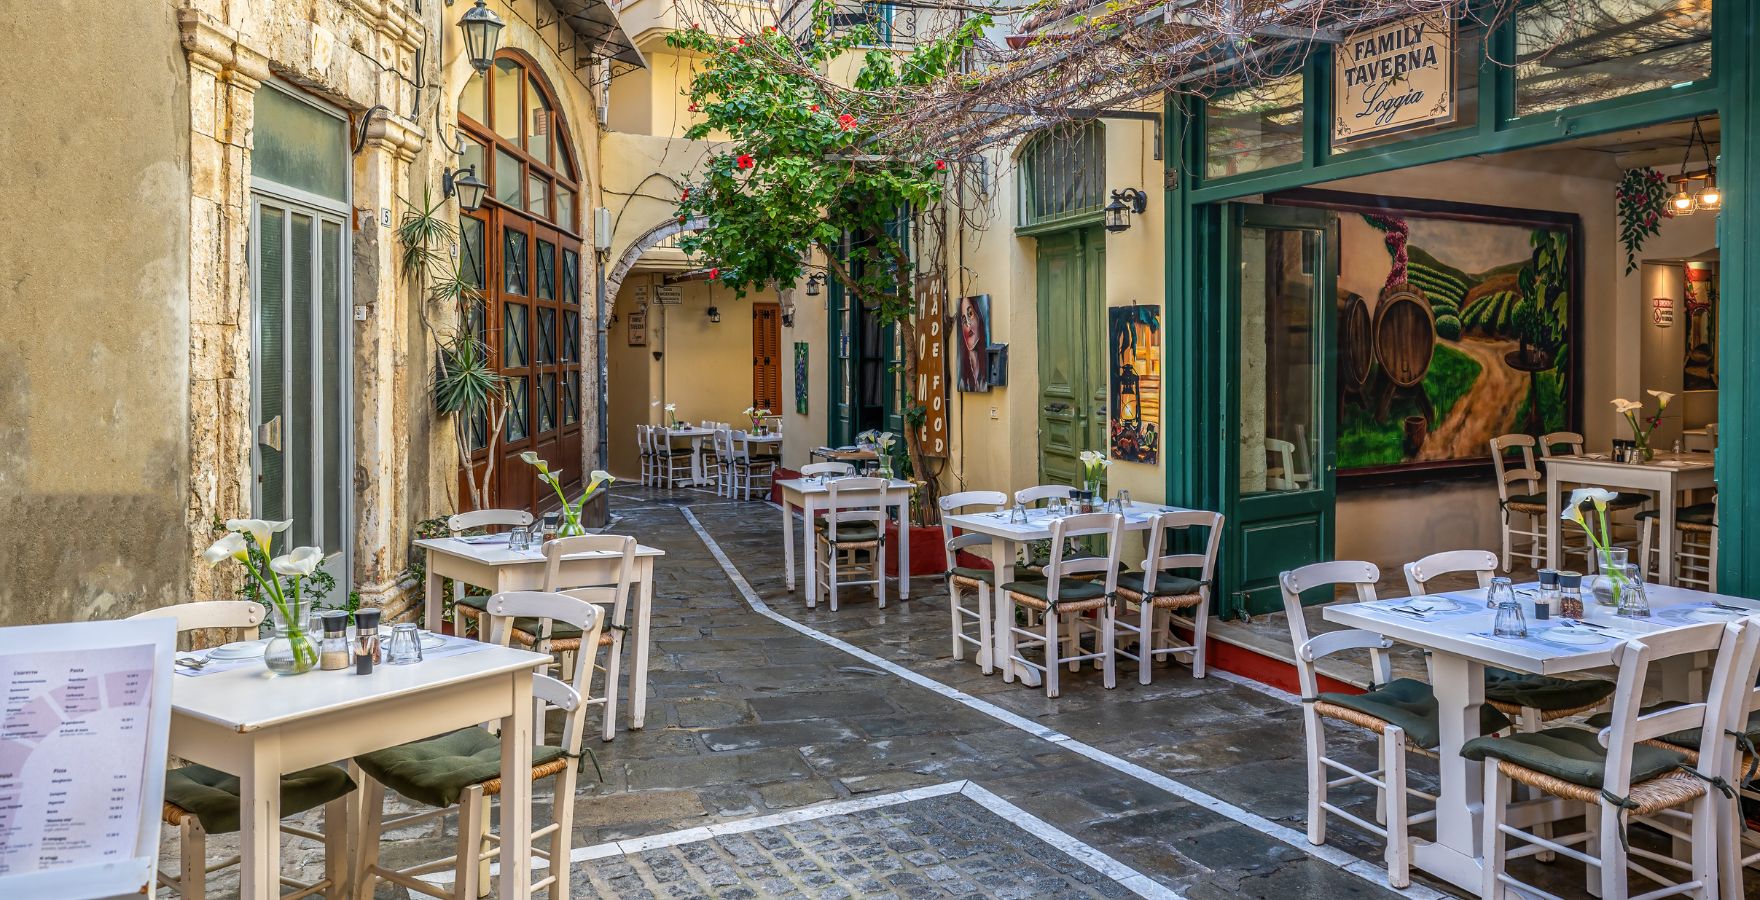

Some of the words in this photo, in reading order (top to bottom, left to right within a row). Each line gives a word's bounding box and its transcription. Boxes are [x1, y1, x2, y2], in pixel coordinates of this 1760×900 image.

[1354, 23, 1426, 62] FAMILY
[1344, 46, 1437, 87] TAVERNA
[1355, 81, 1424, 125] Loggia
[385, 211, 389, 223] 5
[930, 279, 940, 357] MADE
[919, 292, 927, 441] HOME
[933, 376, 943, 452] FOOD
